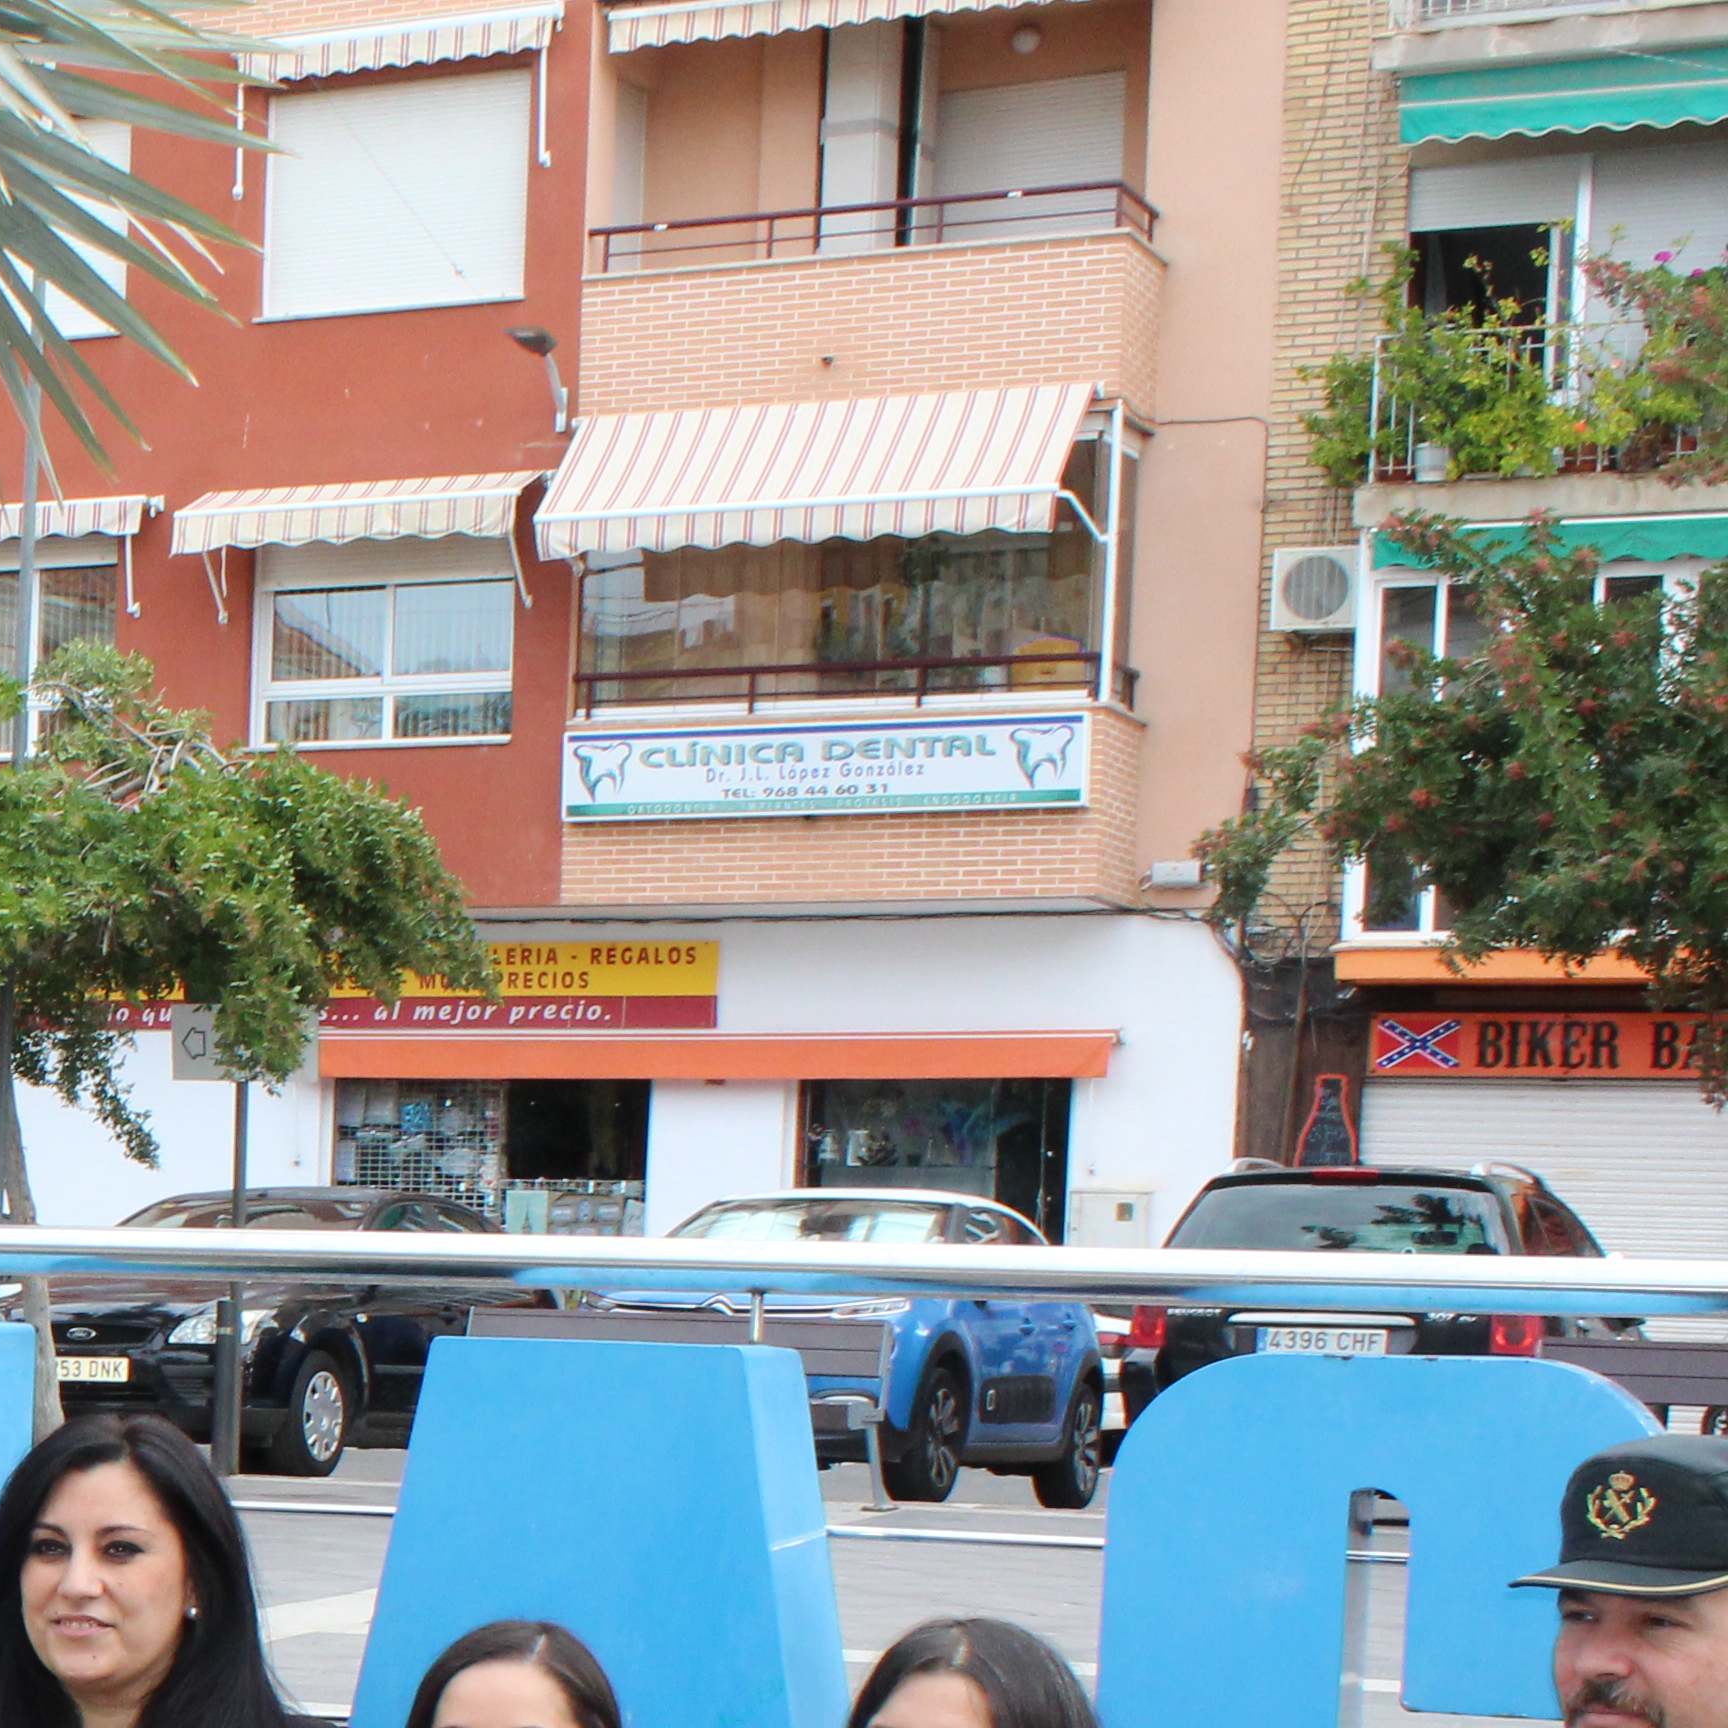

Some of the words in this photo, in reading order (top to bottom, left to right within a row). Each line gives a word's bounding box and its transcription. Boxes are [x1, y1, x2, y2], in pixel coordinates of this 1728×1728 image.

[638, 740, 805, 768] CLÍNICA
[820, 734, 996, 761] DENTAL
[705, 768, 731, 783] Dr.
[779, 764, 830, 783] López
[839, 760, 925, 778] González
[762, 786, 798, 798] 968
[803, 786, 829, 797] 44
[834, 784, 858, 796] 60
[865, 783, 888, 794] 31
[590, 946, 697, 966] REGALOS
[374, 1001, 401, 1021] al
[413, 1002, 498, 1026] mejor
[509, 1001, 612, 1024] precio.
[1475, 1020, 1621, 1069] BIKER
[1268, 1331, 1328, 1351] 4396
[1336, 1331, 1382, 1352] CHF
[55, 1360, 82, 1378] 53
[88, 1360, 123, 1378] DNK
